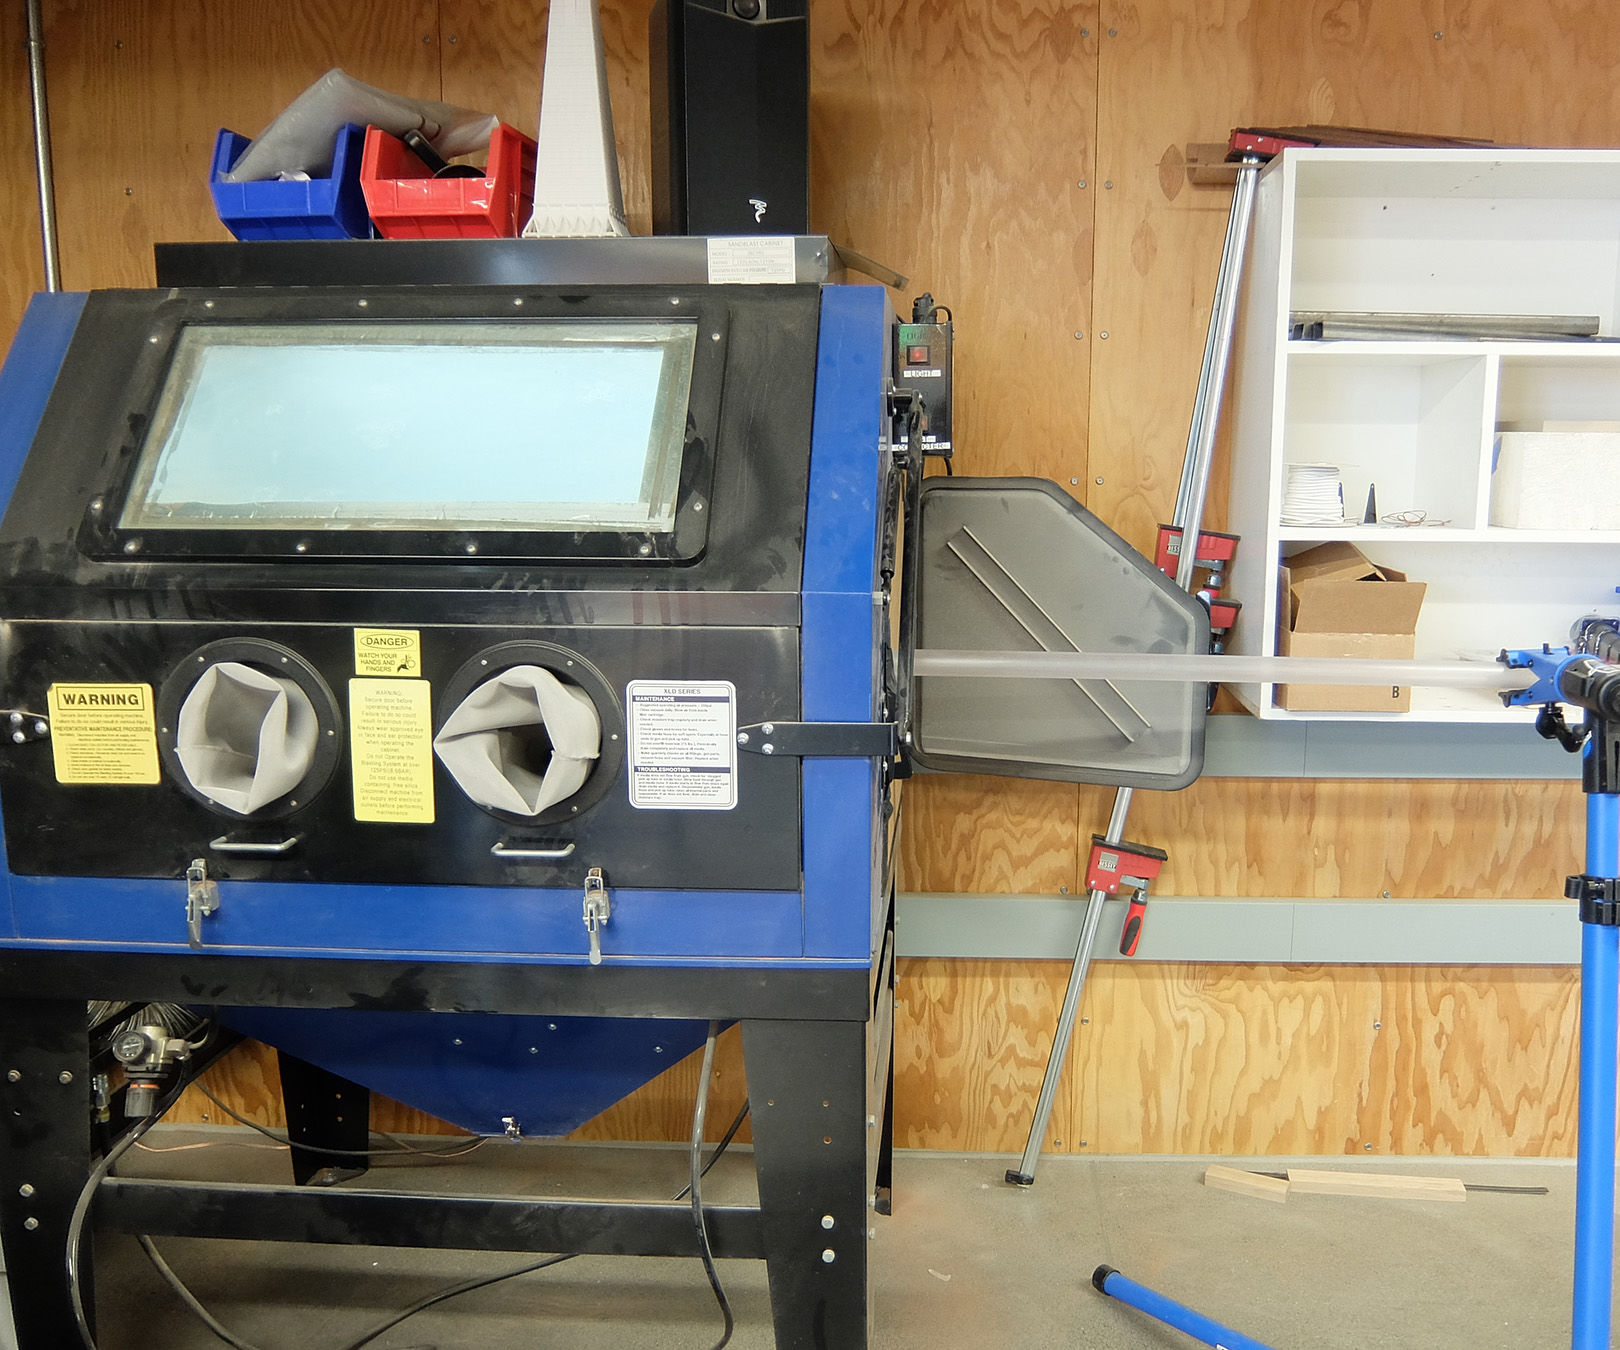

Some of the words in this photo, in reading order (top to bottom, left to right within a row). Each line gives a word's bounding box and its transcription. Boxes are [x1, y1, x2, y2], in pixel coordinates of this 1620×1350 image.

[367, 638, 407, 646] DANGER
[1392, 686, 1400, 698] B
[63, 694, 139, 705] WARNING
